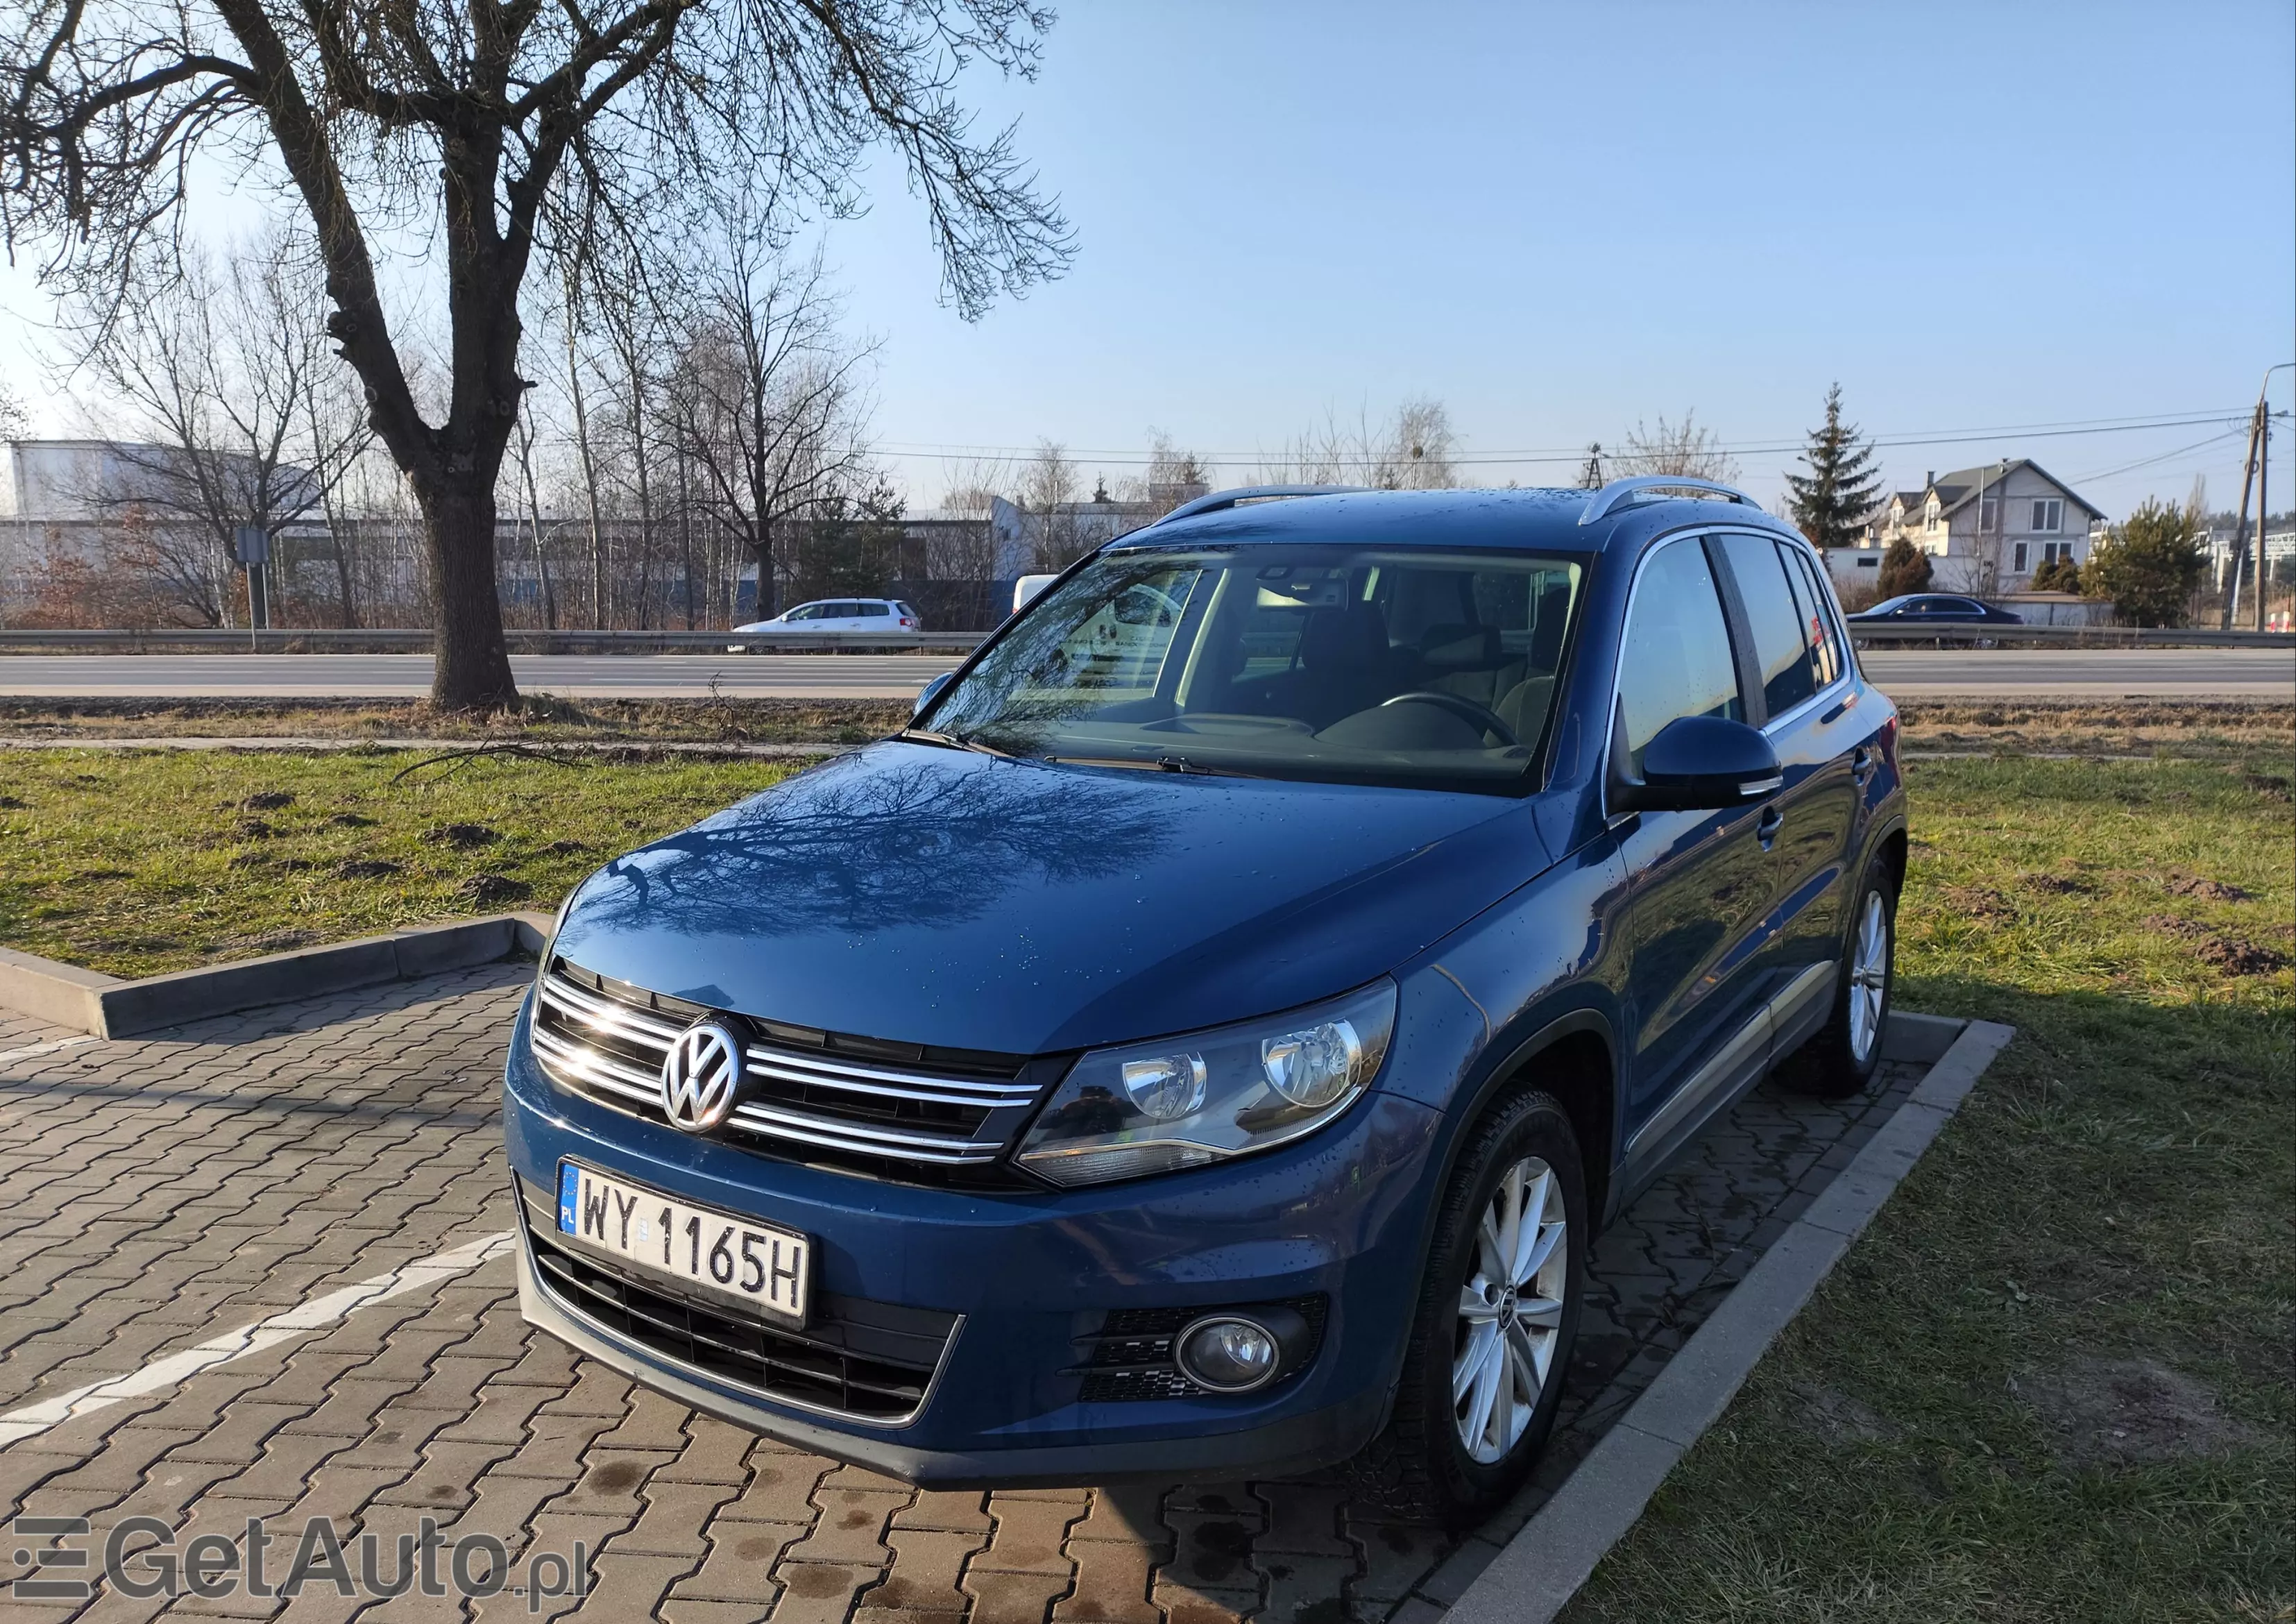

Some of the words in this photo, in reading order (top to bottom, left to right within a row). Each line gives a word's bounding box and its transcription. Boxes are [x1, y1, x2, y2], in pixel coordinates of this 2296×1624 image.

[666, 1026, 737, 1128] VW
[561, 1205, 575, 1224] PL
[584, 1178, 638, 1250] WY
[658, 1207, 801, 1308] 1165H
